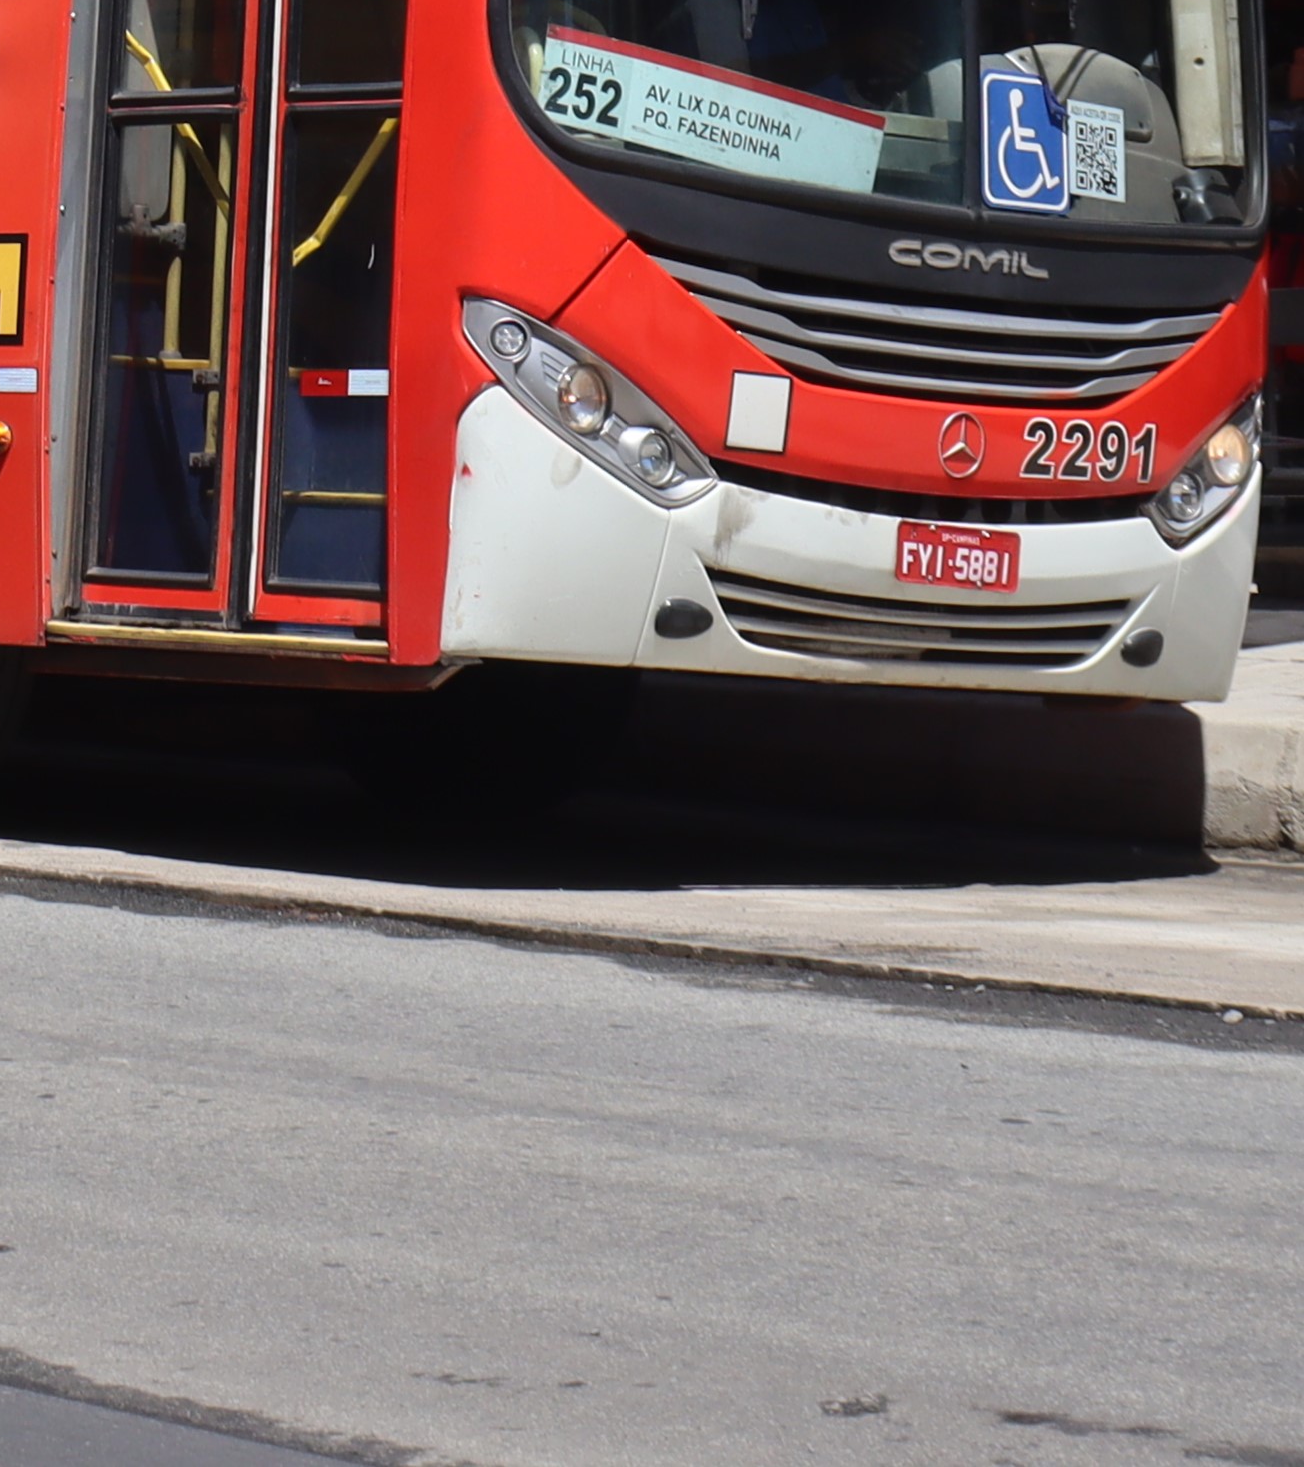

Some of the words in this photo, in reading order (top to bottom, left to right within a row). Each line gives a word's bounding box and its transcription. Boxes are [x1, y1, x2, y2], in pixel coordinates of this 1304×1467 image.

[561, 48, 616, 77] LINHA
[543, 66, 623, 128] 252
[645, 83, 671, 106] AV.
[677, 91, 704, 114] LIX
[708, 100, 732, 122] DA
[735, 109, 793, 140] CUNHA
[643, 107, 671, 130] PQ.
[677, 117, 781, 162] FAZENDINHA
[888, 239, 1050, 280] COMIL
[1019, 416, 1157, 484] 2291
